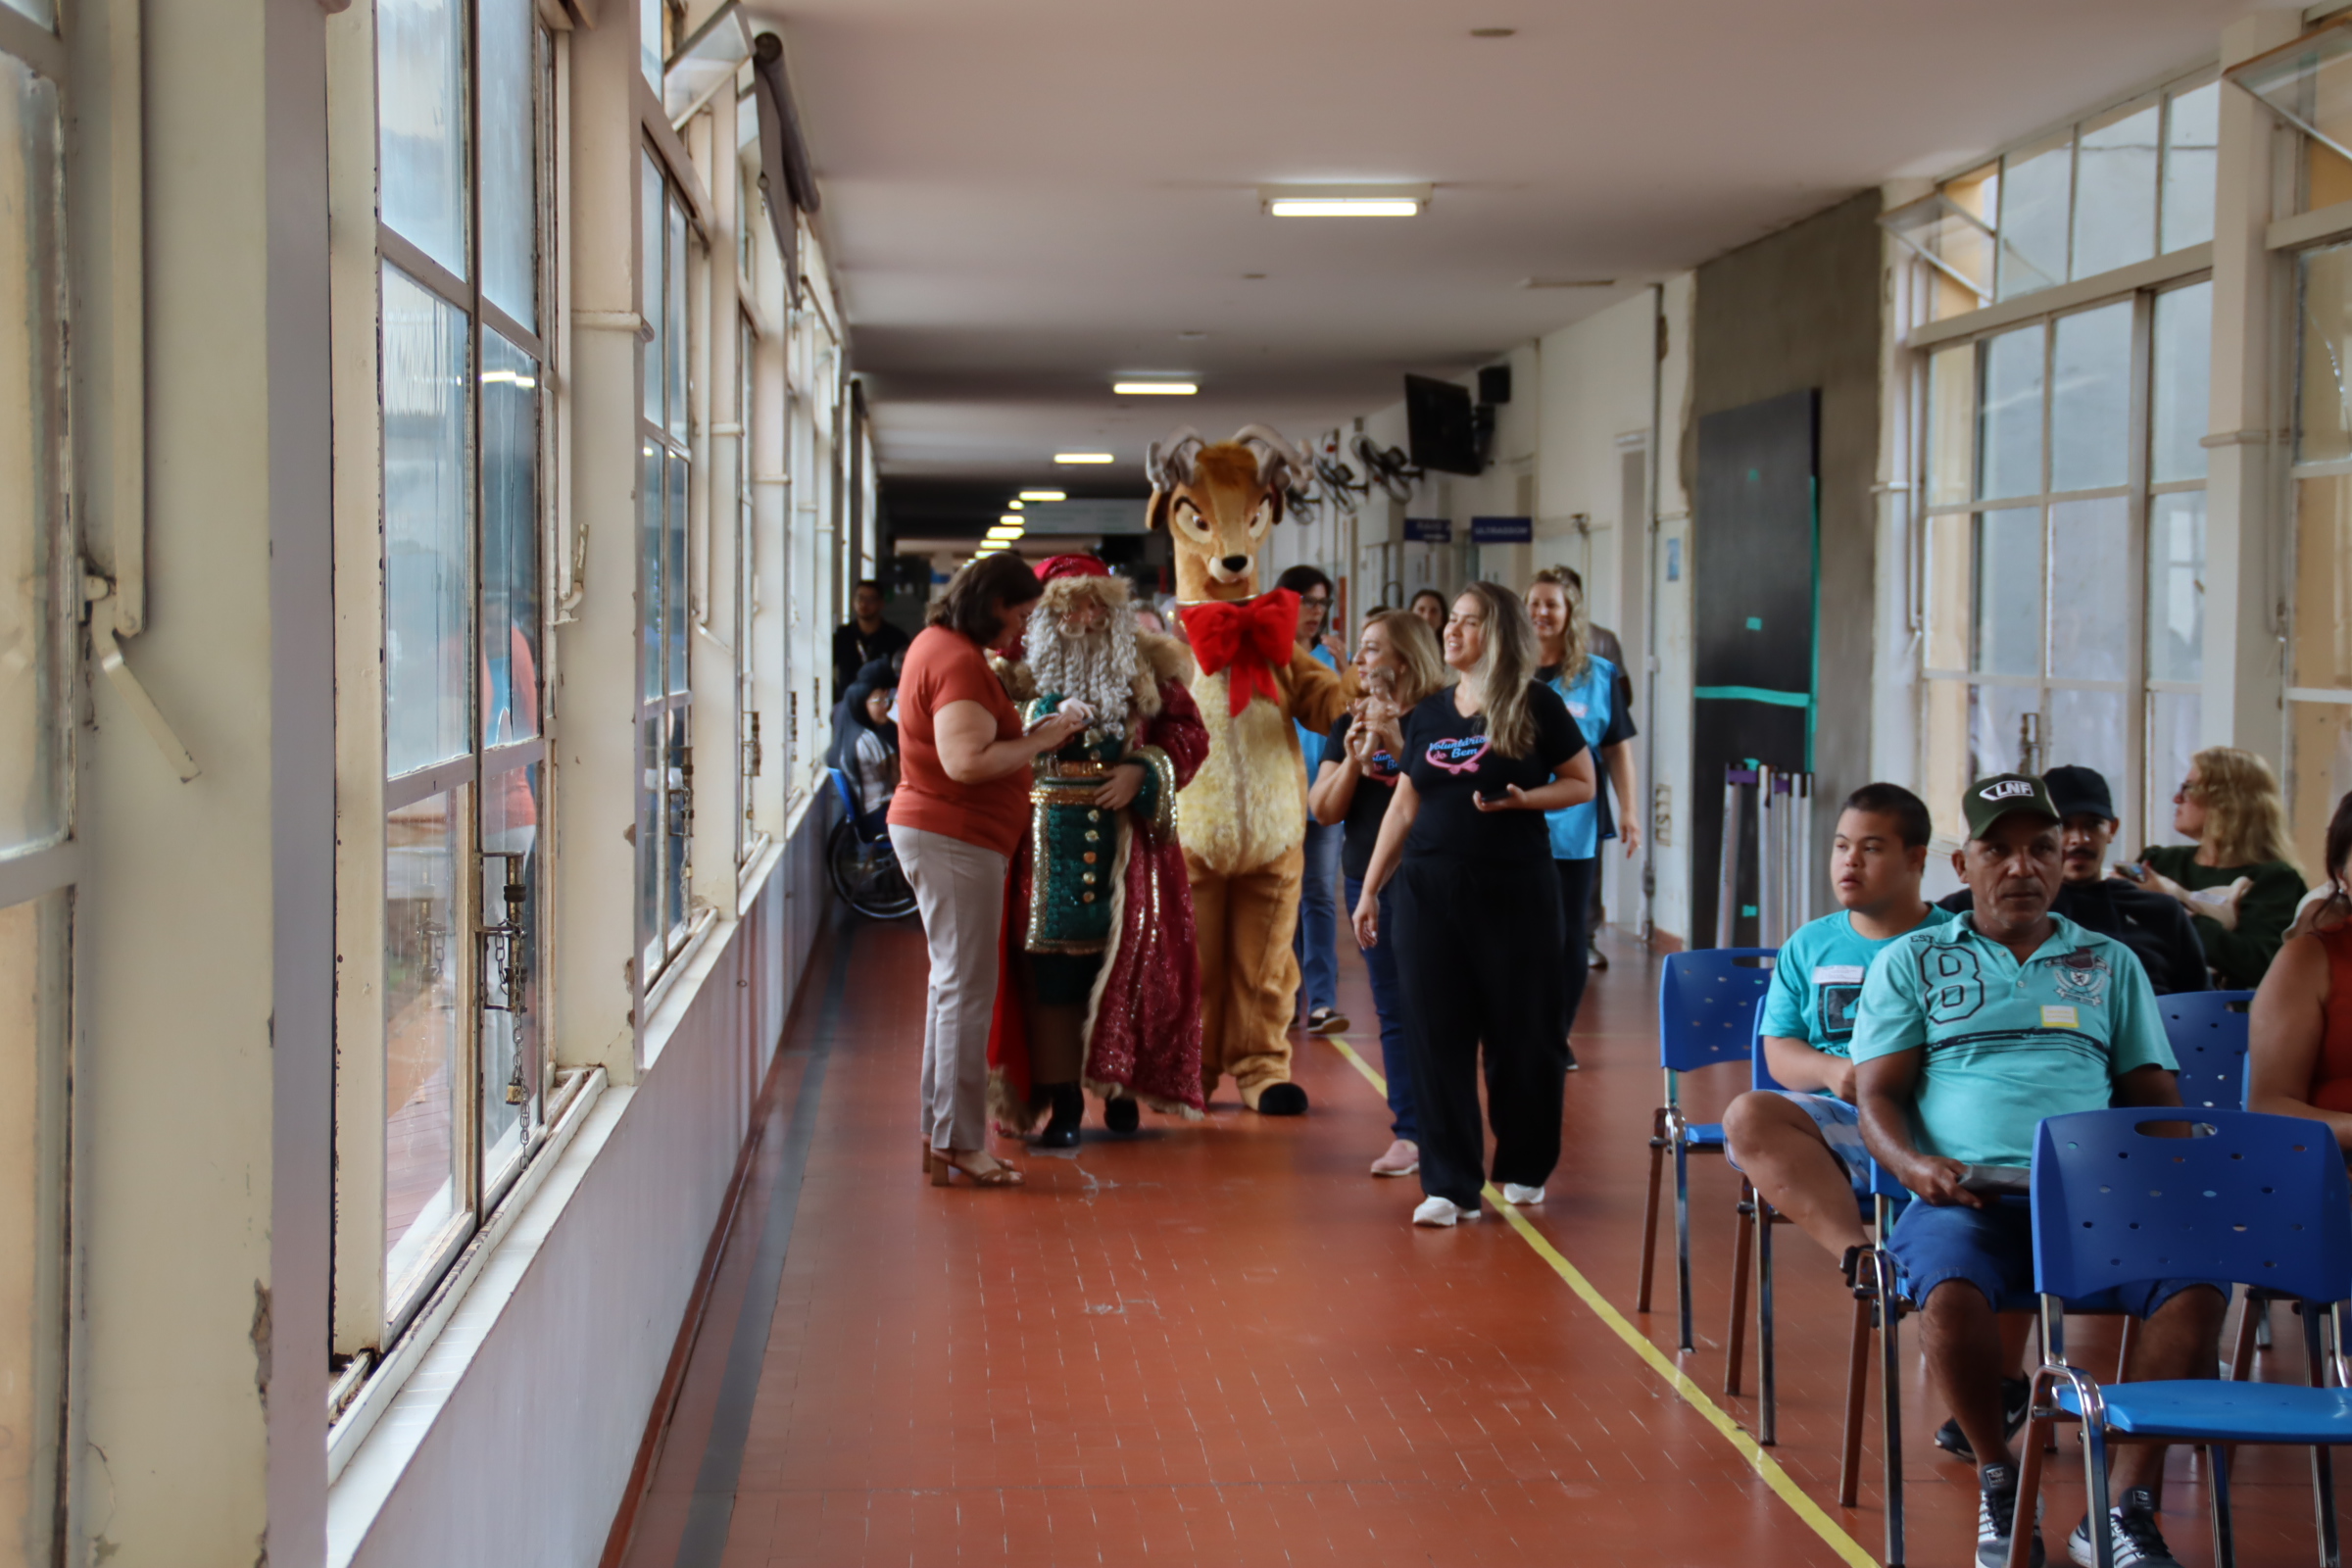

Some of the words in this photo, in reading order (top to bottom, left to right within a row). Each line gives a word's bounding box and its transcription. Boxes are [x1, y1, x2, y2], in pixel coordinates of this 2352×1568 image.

[1451, 747, 1478, 759] Bem
[1995, 782, 2031, 797] LNF
[1910, 934, 1935, 944] EST
[1919, 944, 1984, 1026] 8
